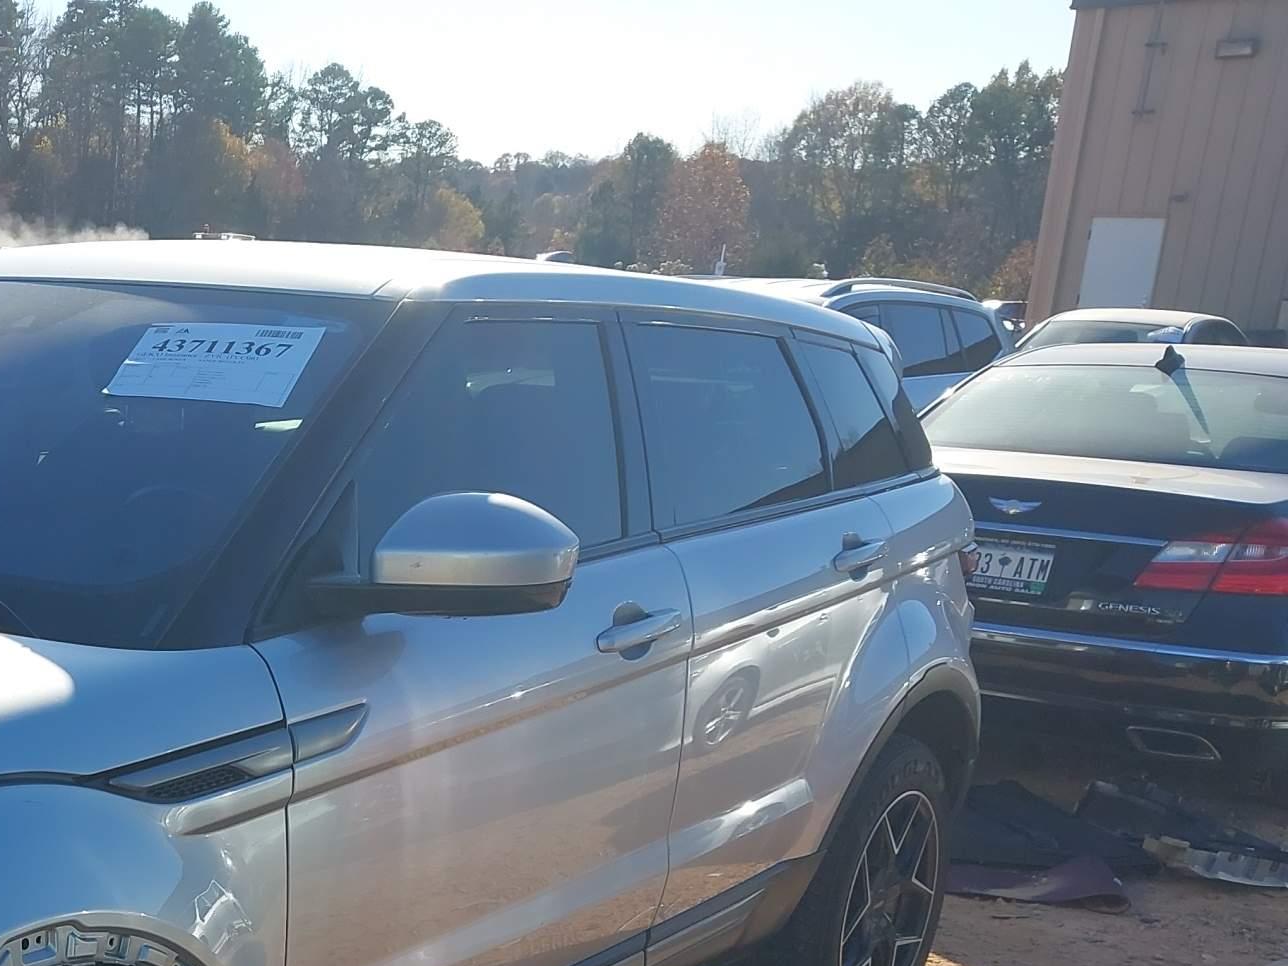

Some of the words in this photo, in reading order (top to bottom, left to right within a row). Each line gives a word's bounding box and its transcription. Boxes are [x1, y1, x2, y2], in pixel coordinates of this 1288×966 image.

[152, 338, 294, 358] 43711367
[1013, 556, 1051, 581] ATM
[1098, 602, 1160, 615] GENESIS
